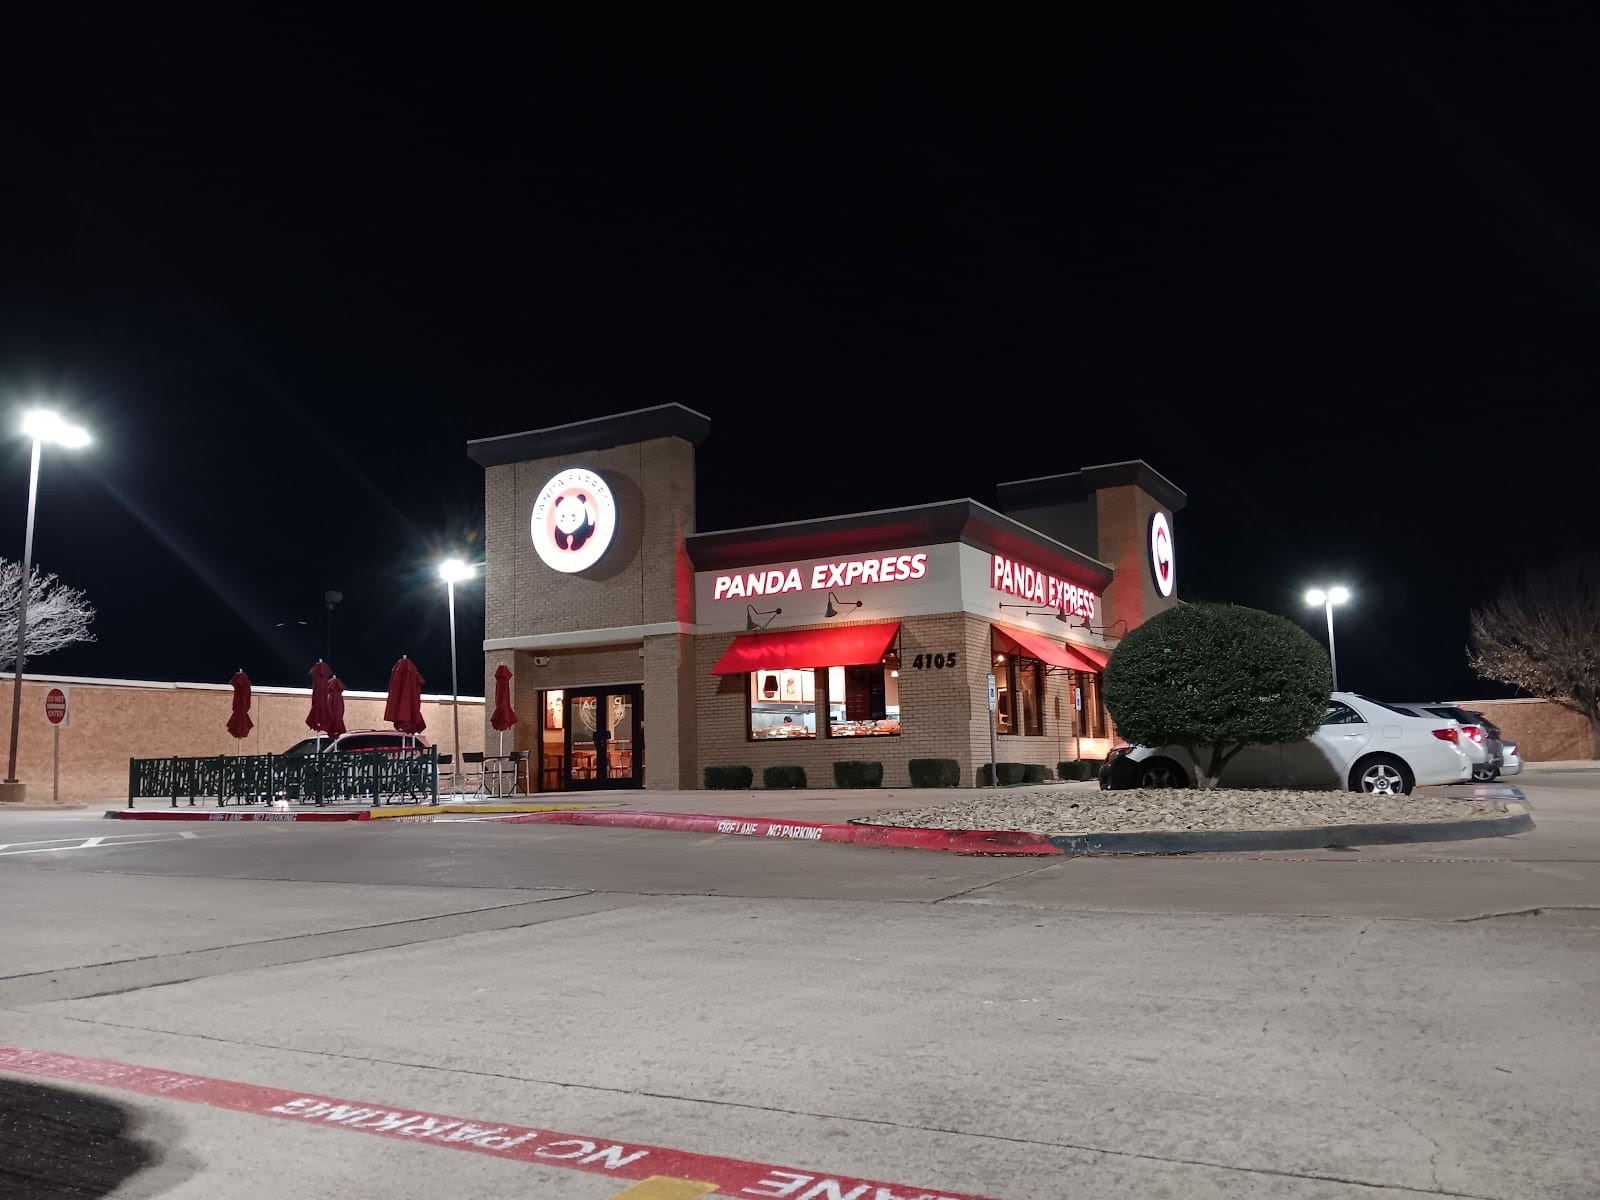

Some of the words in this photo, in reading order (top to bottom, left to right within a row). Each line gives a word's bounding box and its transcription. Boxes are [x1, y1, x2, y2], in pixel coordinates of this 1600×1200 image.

[714, 568, 803, 600] PANDA
[811, 553, 927, 589] EXPRESS
[992, 554, 1045, 604] PANDA
[1047, 575, 1095, 620] EXPRESS
[912, 652, 957, 669] 4105
[208, 813, 225, 821] FIRE
[224, 813, 243, 821] LANE
[265, 813, 298, 821] PARKING
[718, 822, 736, 834] FIRE
[735, 822, 759, 835] LANE
[766, 824, 782, 837] NO
[781, 826, 823, 840] PARKING
[270, 1098, 538, 1150] PARKING
